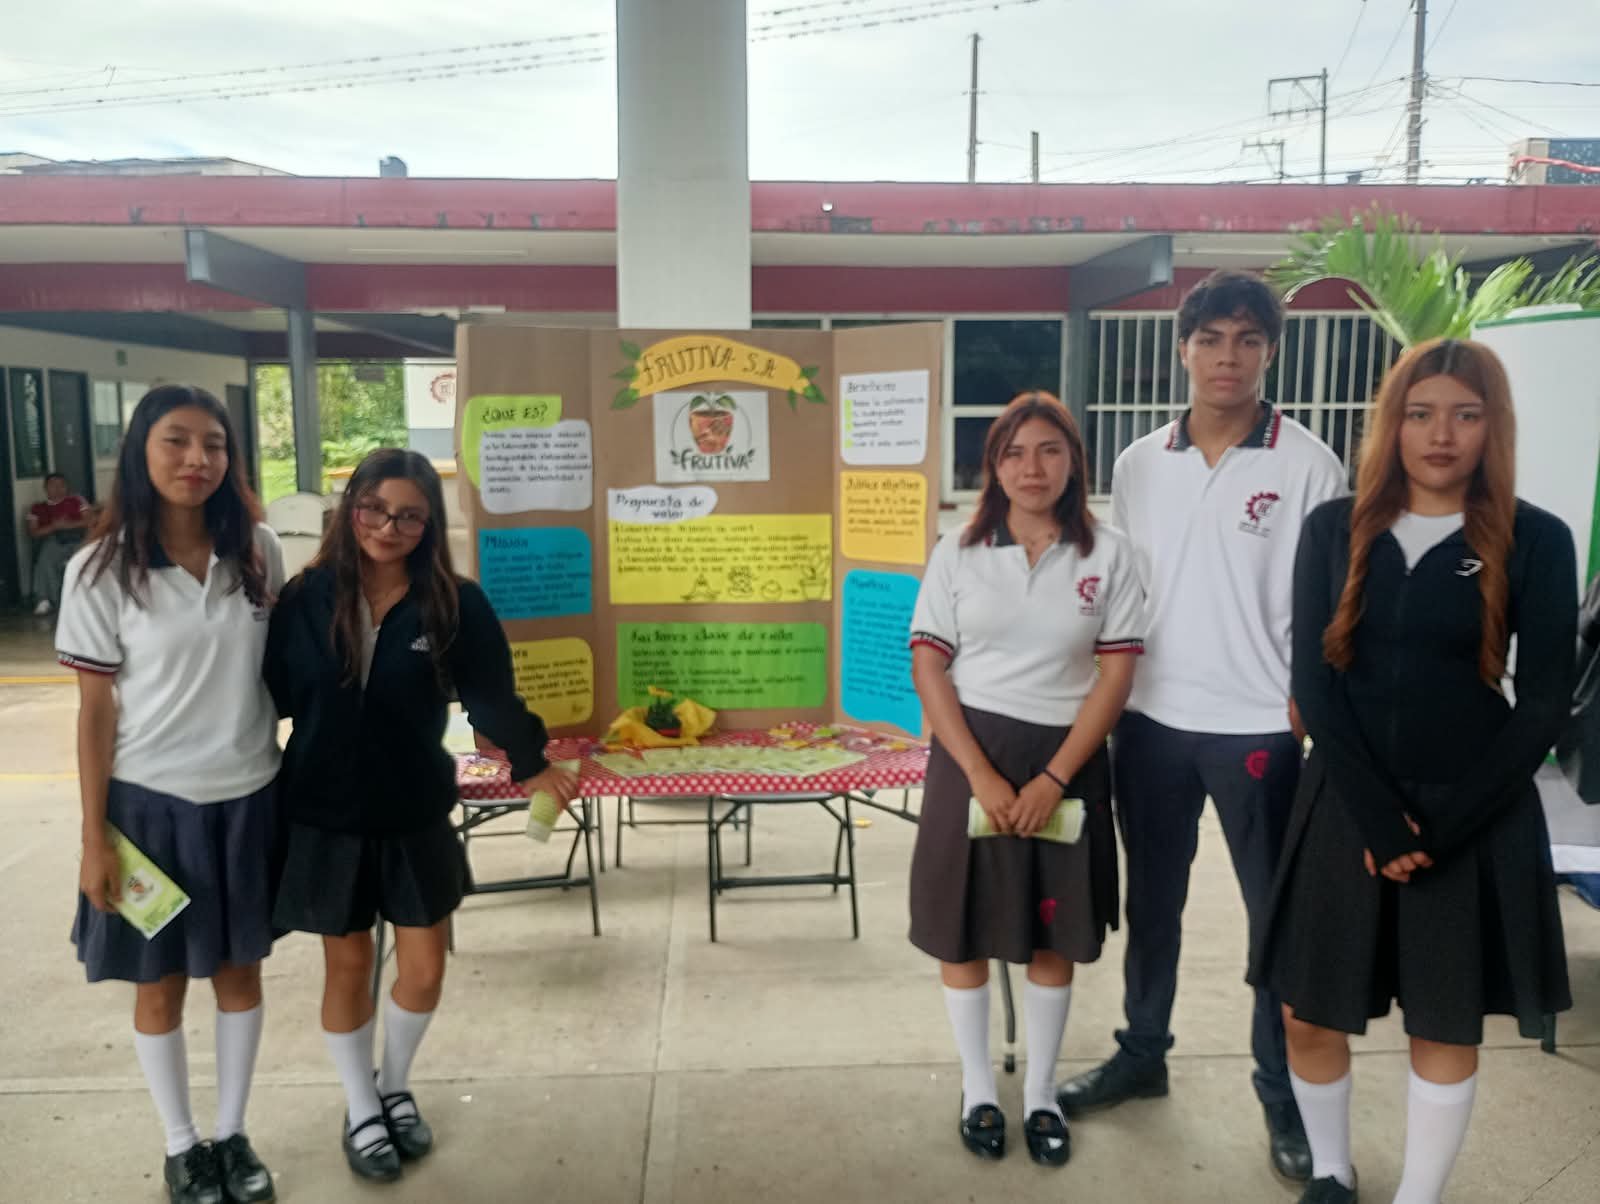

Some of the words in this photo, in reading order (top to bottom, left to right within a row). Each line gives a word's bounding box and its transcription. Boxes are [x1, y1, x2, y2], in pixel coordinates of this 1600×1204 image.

[642, 345, 735, 386] FRUTIVA
[680, 446, 750, 471] FRUTIVA
[615, 494, 682, 512] Propuesta
[652, 508, 684, 519] valor
